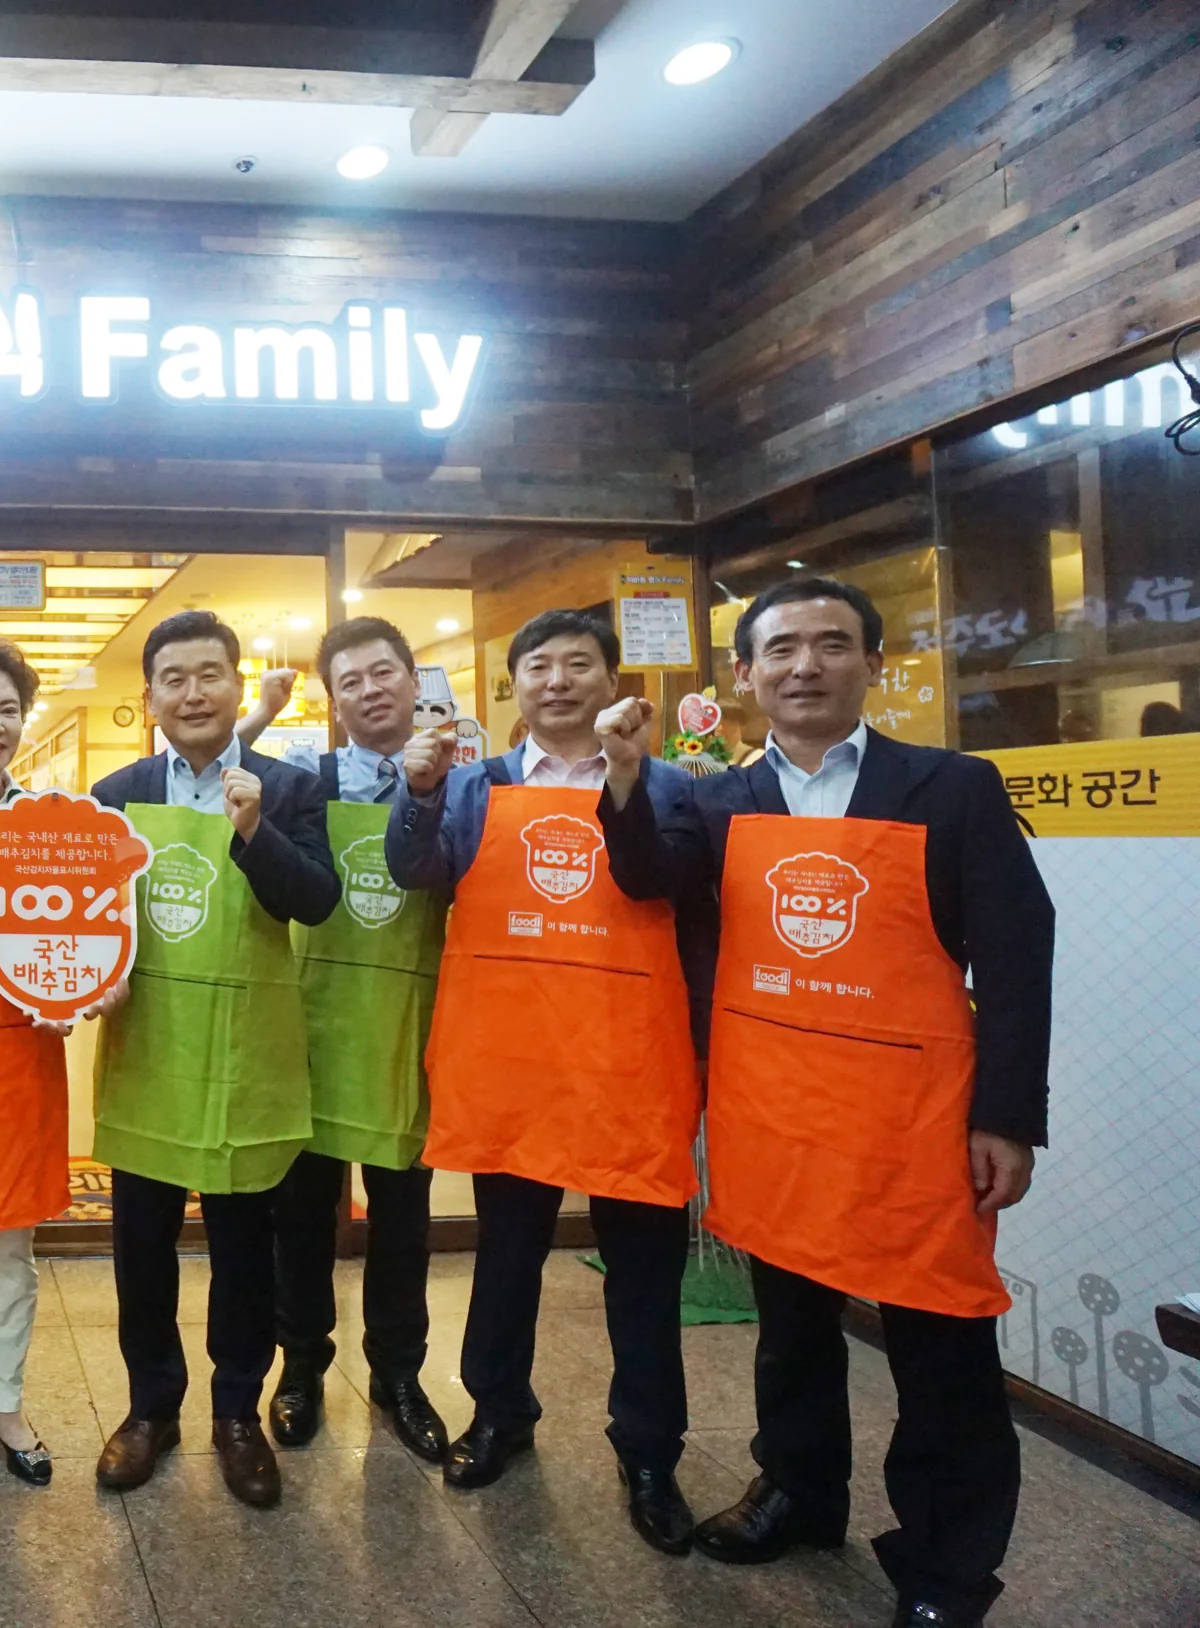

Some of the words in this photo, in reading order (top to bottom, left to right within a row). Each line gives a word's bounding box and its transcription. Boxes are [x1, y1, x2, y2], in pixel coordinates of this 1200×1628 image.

[80, 295, 483, 430] Family
[1005, 773, 1073, 809] 문화
[1081, 768, 1161, 809] 공간
[27, 831, 58, 844] 국내산
[62, 832, 94, 844] 재료로
[97, 833, 119, 846] 만든
[0, 847, 50, 861] 배추김치를
[55, 849, 112, 861] 제공합니다.
[534, 848, 587, 868] 100%
[152, 882, 202, 904] 100%
[781, 894, 847, 916] 100%
[789, 929, 835, 945] 배추김치
[33, 934, 79, 966] 국산
[13, 962, 102, 996] 배추김치
[795, 978, 806, 990] 이
[809, 979, 832, 993] 함께
